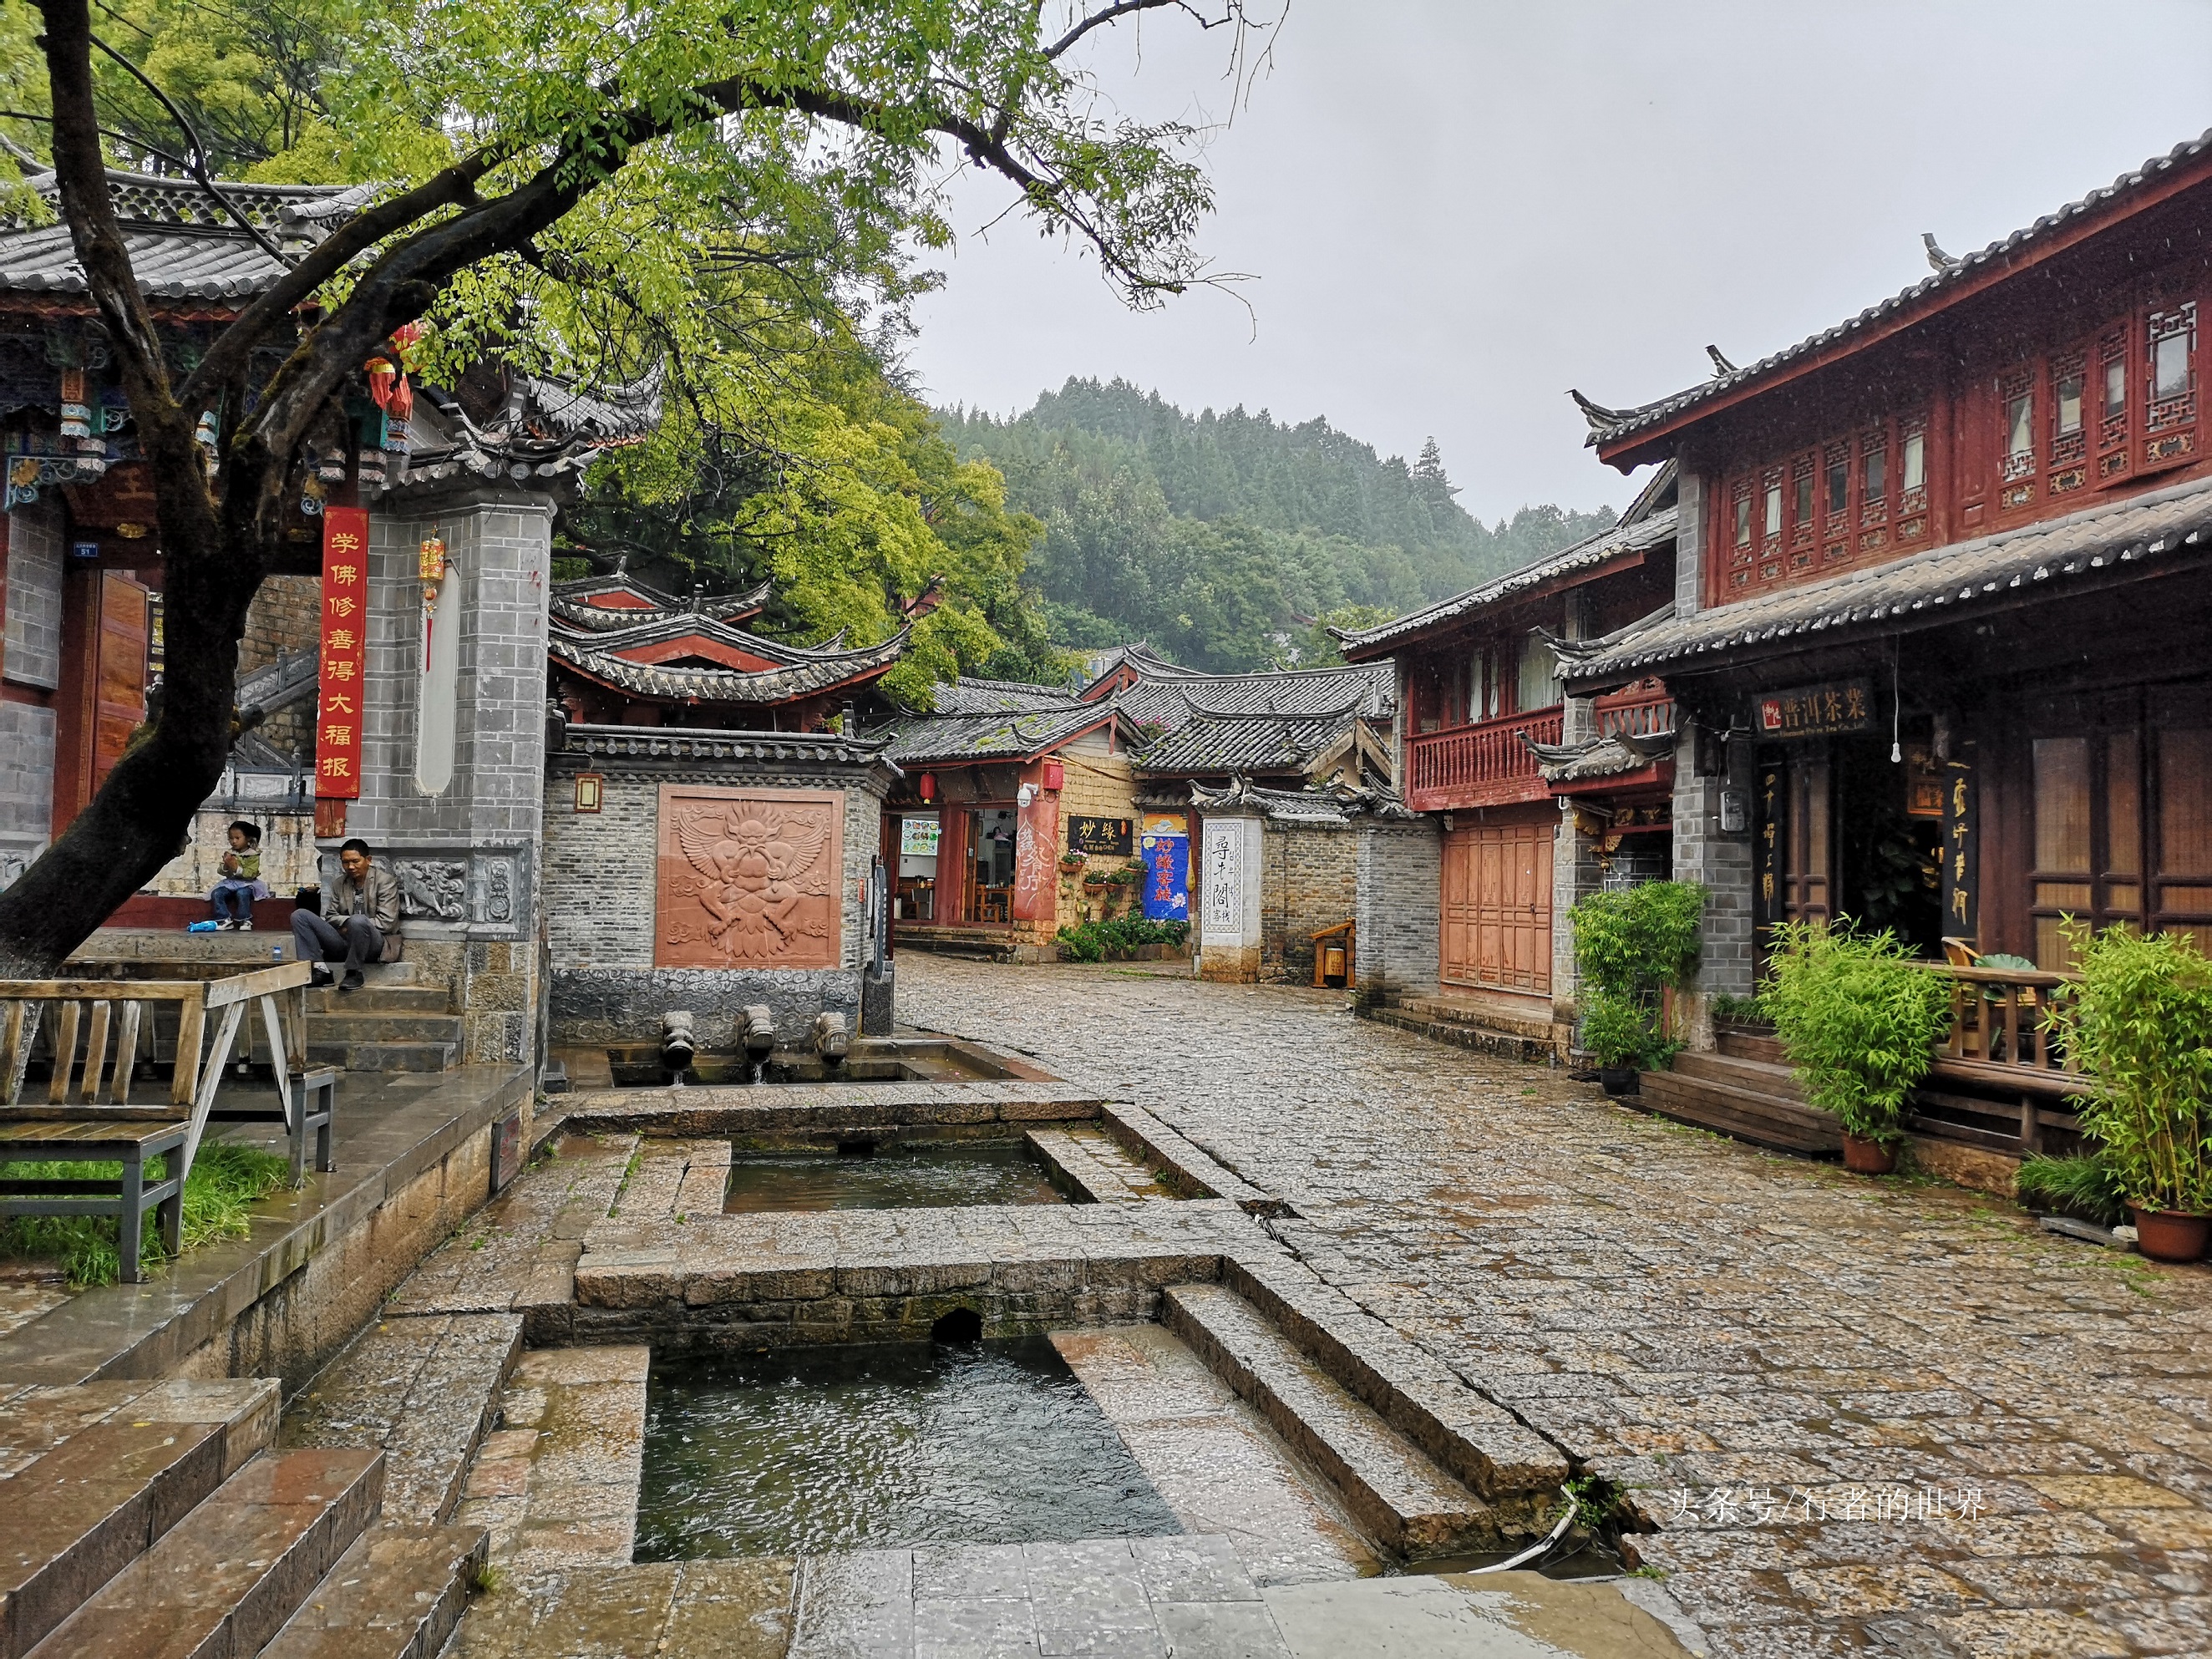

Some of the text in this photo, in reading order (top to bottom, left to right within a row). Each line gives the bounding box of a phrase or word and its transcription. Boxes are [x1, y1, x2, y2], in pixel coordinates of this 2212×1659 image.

[322, 532, 360, 778] 学佛修善得大福报
